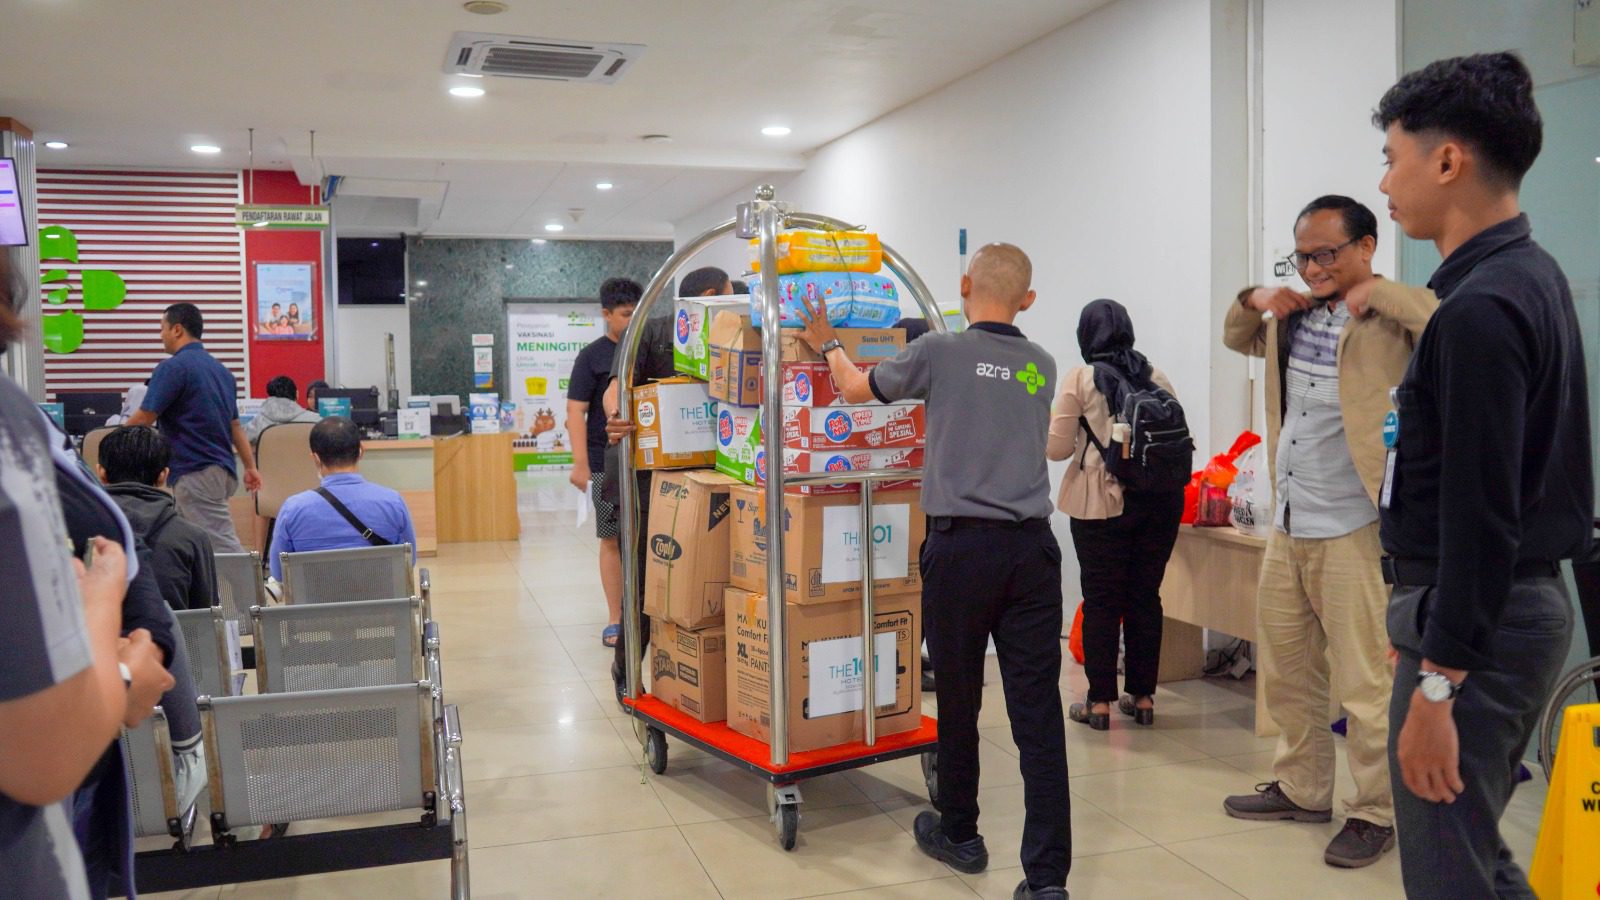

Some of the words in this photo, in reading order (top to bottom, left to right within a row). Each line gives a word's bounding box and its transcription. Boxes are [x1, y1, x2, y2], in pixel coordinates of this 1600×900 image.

[242, 211, 282, 221] PENDAFTARAN
[283, 211, 303, 222] RAWAT
[304, 212, 322, 222] JALAN
[861, 335, 879, 344] Susu
[880, 335, 895, 343] UHT
[976, 362, 1011, 380] azra
[680, 401, 718, 420] THE10
[737, 613, 767, 630] MAKU
[900, 617, 908, 626] Fit
[737, 626, 762, 642] Comfort
[737, 641, 749, 659] XL
[829, 654, 879, 679] THE11
